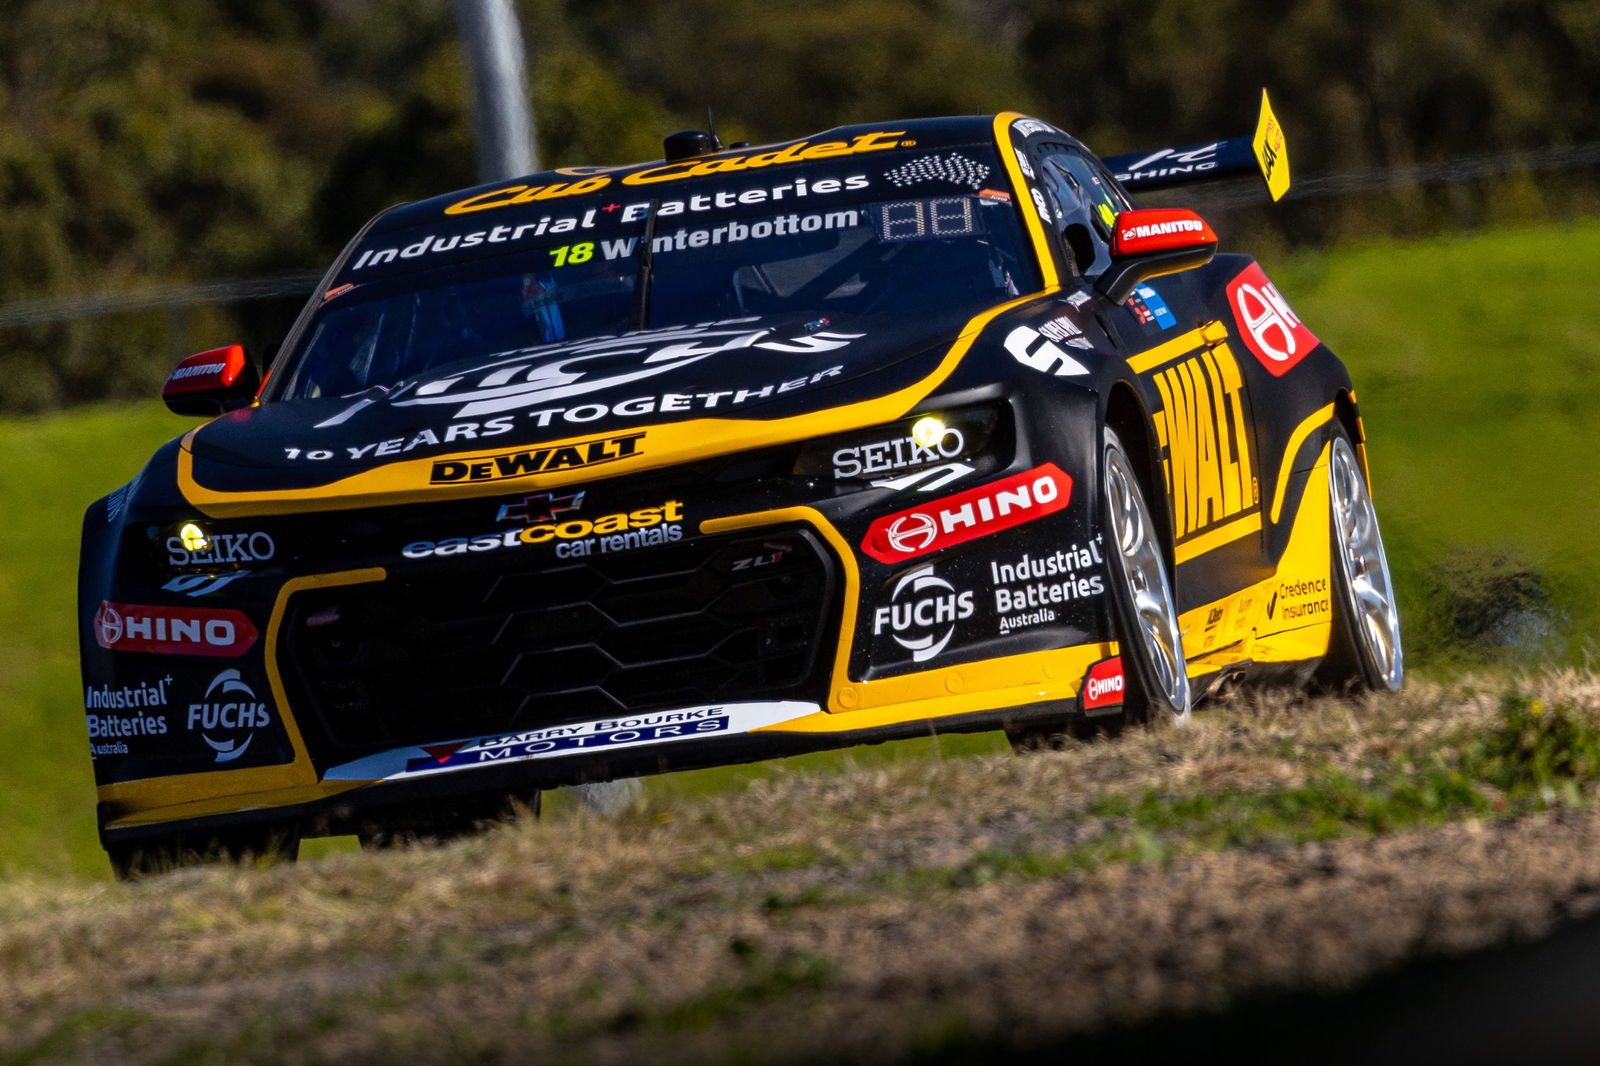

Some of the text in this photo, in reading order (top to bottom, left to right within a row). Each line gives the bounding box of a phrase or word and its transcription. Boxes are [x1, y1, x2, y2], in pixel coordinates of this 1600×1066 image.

[444, 132, 906, 215] Cub Cadet
[620, 175, 870, 223] Batteries
[549, 210, 858, 268] 18 Wnterbottom
[1136, 219, 1204, 238] MANITOU
[346, 415, 515, 460] YEARS
[528, 364, 845, 428] TOGETHER
[831, 426, 965, 479] SEIKO
[939, 475, 1059, 534] HINO
[166, 531, 276, 566] SEIKO
[555, 523, 683, 559] car rentals
[995, 573, 1105, 614] Batteries
[1279, 577, 1327, 600] Credence
[873, 590, 975, 636] FUCHS
[999, 609, 1056, 634] Australia
[1281, 598, 1329, 621] Insurance
[125, 615, 236, 646] HINO
[86, 711, 168, 738] Batteries
[186, 702, 271, 730] FUCHS
[479, 706, 724, 749] BARRY BOURKE
[478, 719, 721, 762] MOTORS
